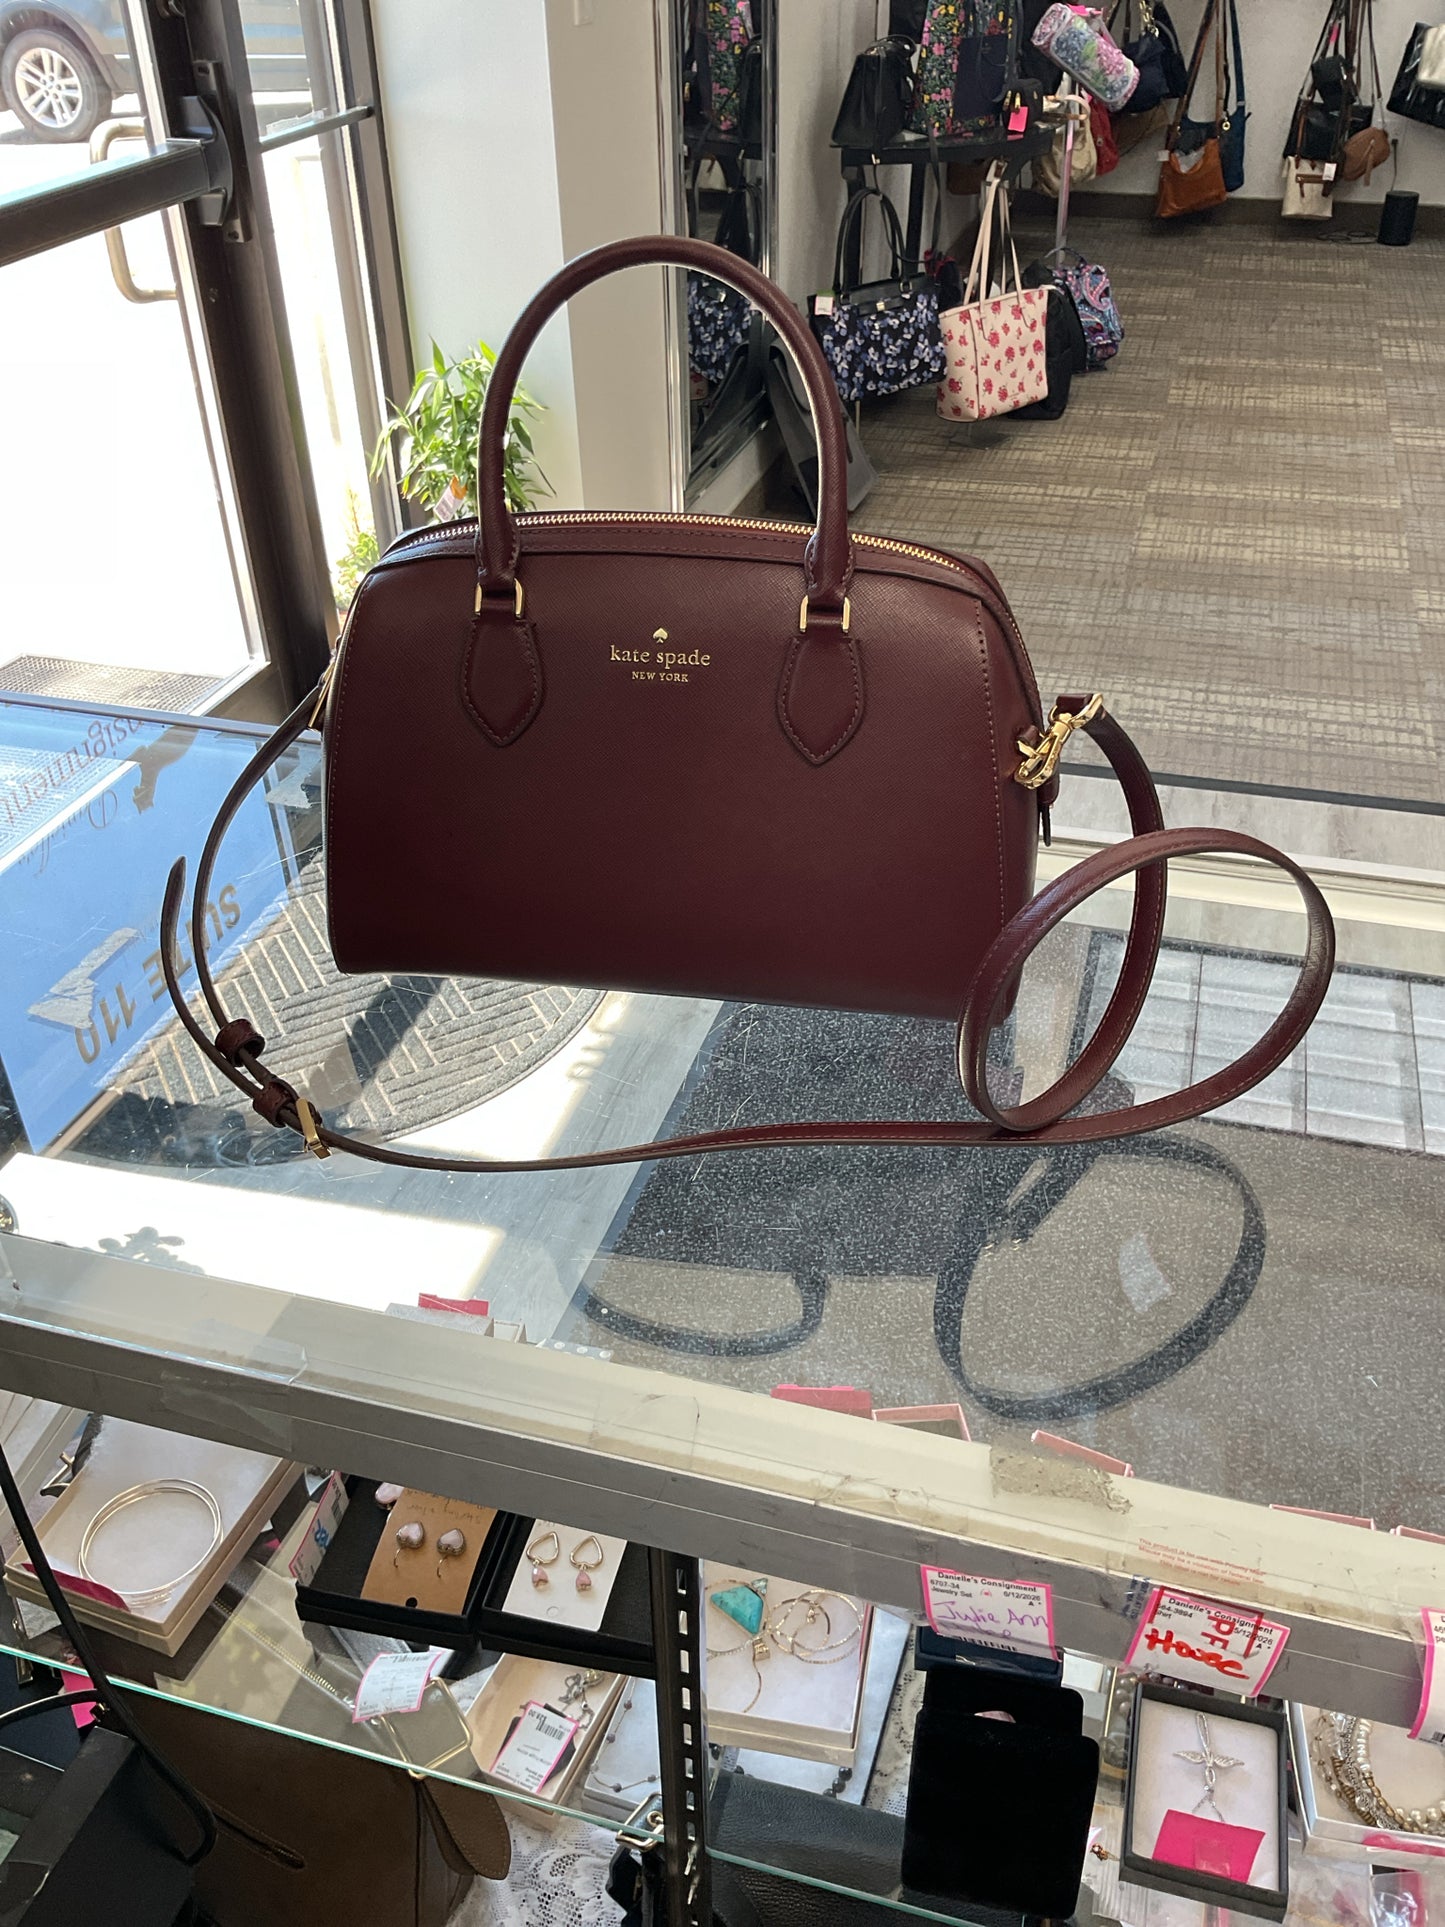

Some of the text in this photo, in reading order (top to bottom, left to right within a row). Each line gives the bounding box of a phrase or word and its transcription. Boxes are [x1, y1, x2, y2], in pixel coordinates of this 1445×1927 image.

[610, 644, 711, 670] kate spade
[631, 671, 689, 683] NEW YORK
[74, 981, 137, 1065] 110
[931, 1586, 973, 1598] Jewelry Set
[937, 1571, 1038, 1593] Danielle's Consignment
[933, 1600, 1000, 1627] Julie
[1168, 1597, 1212, 1615] Danielle's
[1214, 1610, 1274, 1636] Consignment
